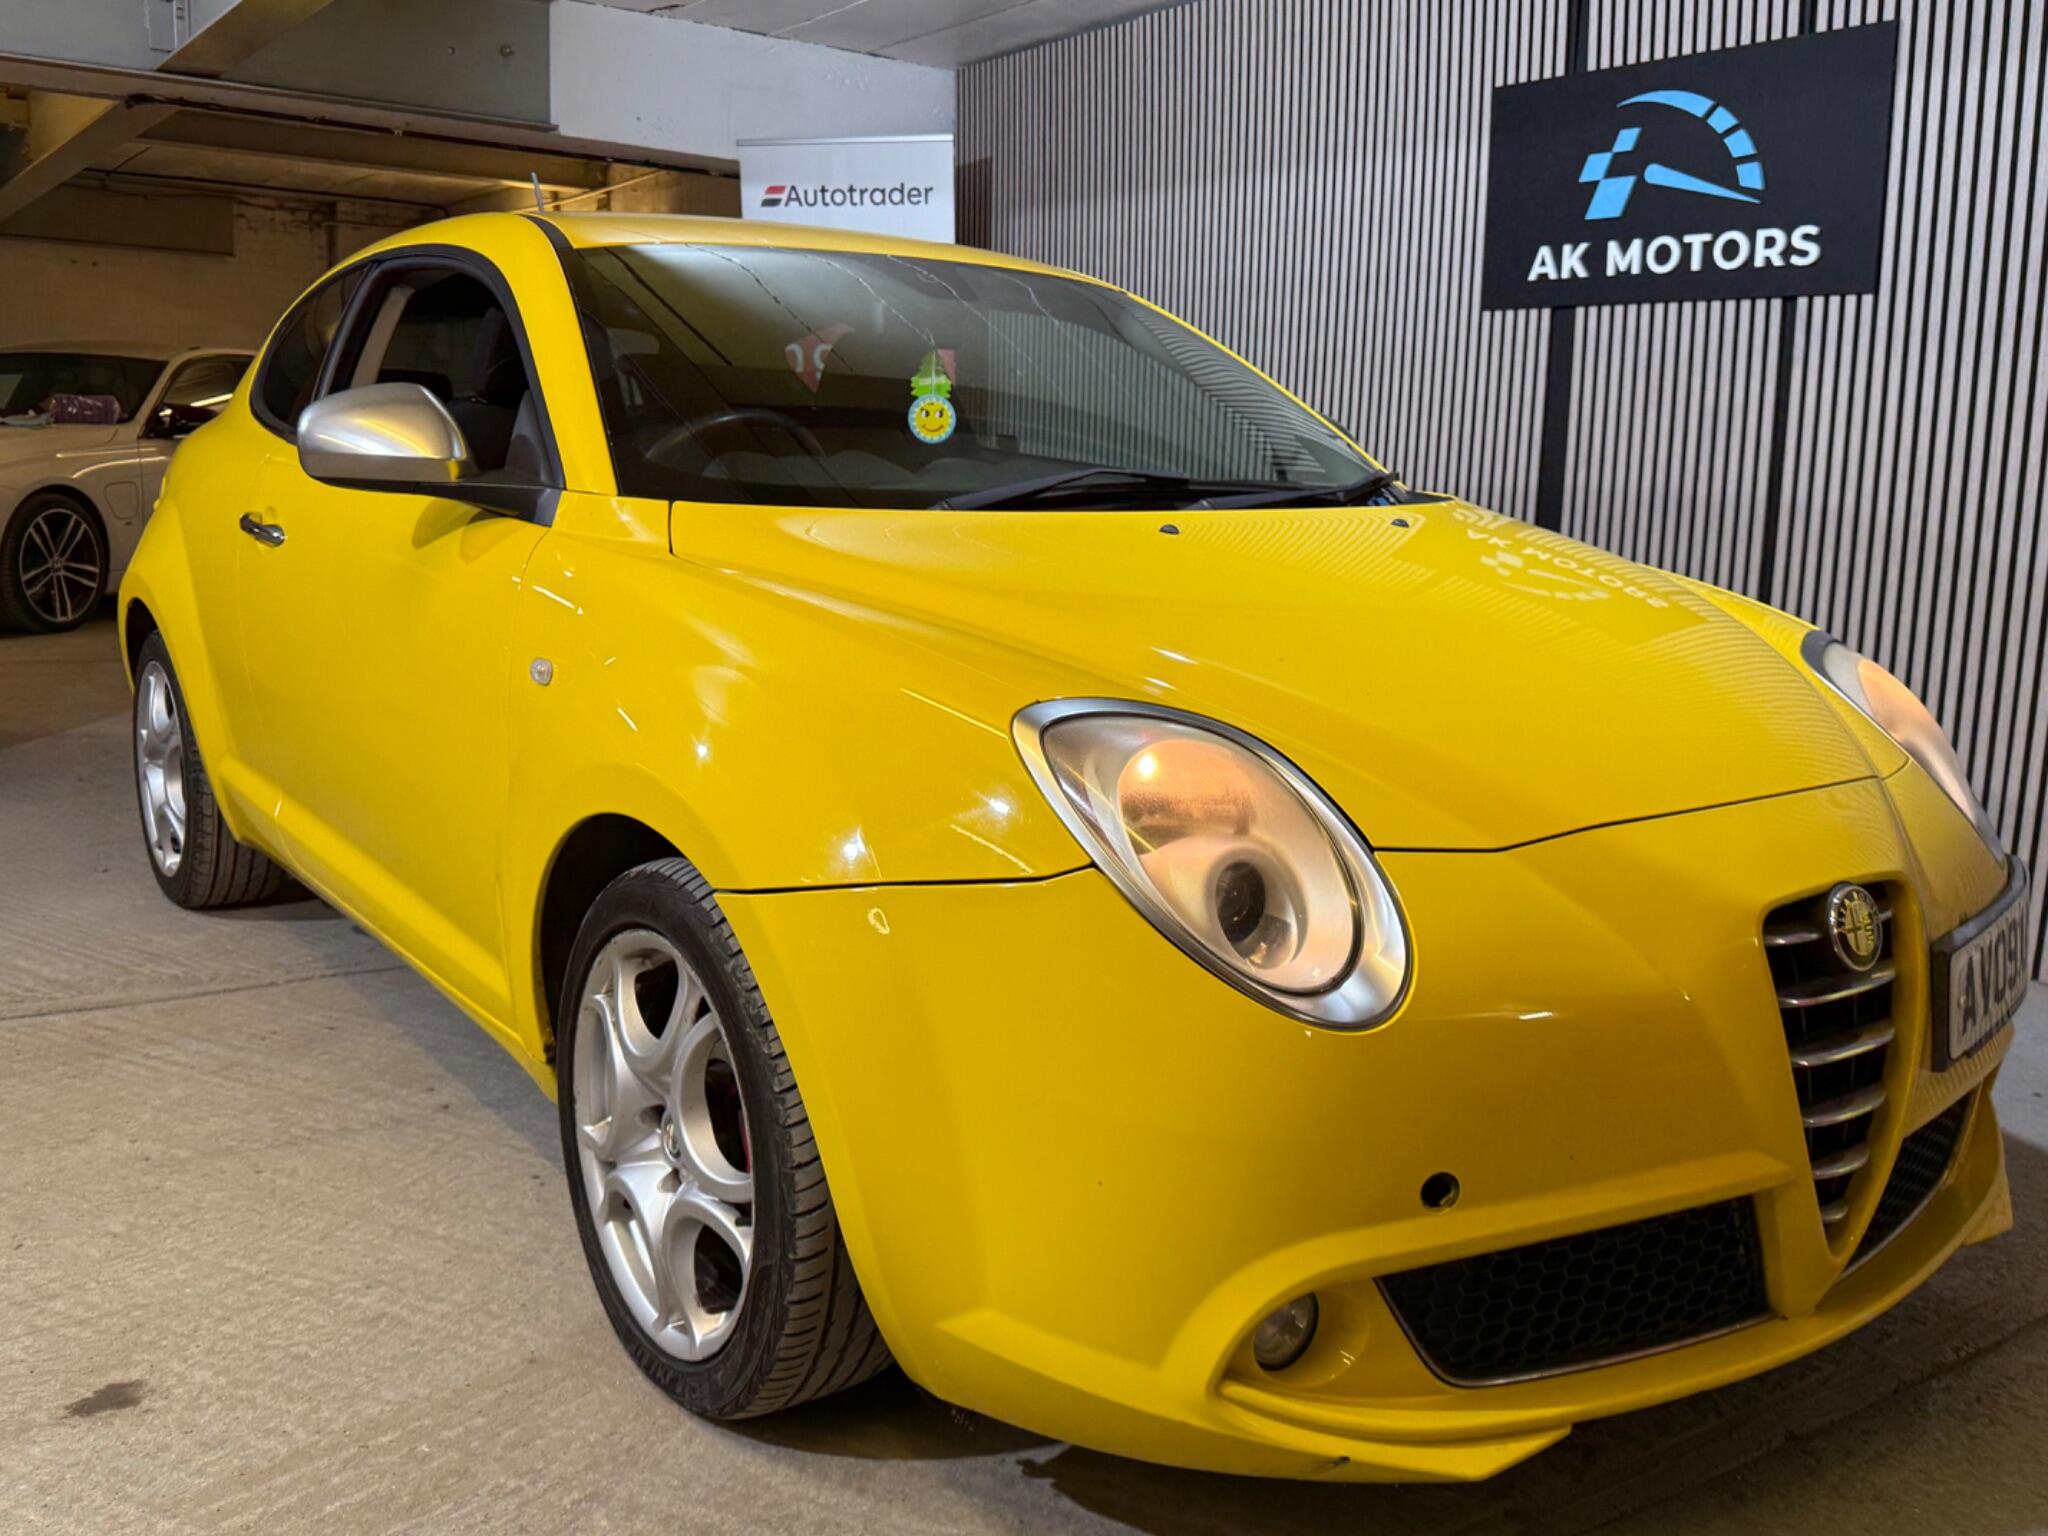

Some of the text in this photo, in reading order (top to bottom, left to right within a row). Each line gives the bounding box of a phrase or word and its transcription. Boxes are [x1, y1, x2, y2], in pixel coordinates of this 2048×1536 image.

[784, 182, 934, 208] Autotrader
[1527, 224, 1821, 282] AK MOTORS
